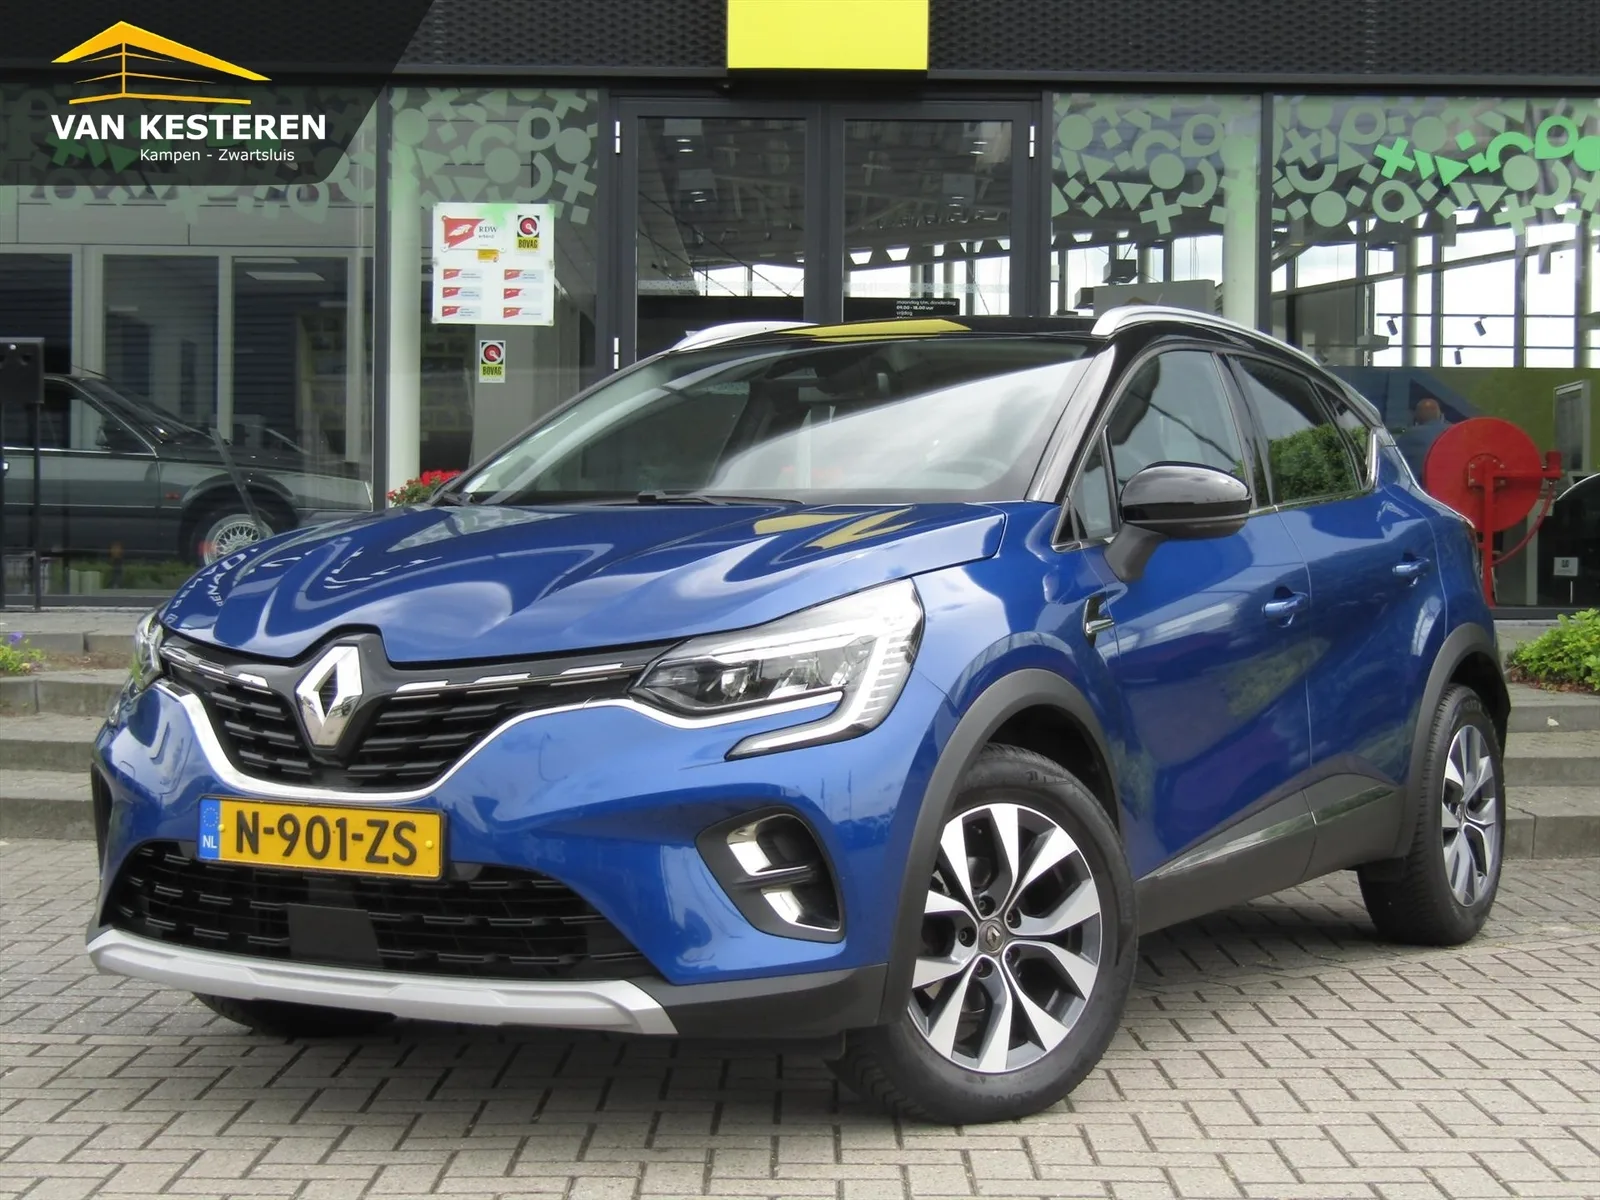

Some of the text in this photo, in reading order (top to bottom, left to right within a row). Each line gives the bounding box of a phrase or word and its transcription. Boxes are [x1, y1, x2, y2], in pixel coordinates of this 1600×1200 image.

[518, 239, 538, 249] BOVAG
[483, 366, 502, 376] BOVAG
[202, 834, 217, 849] NL
[235, 809, 418, 867] N-901-ZS
